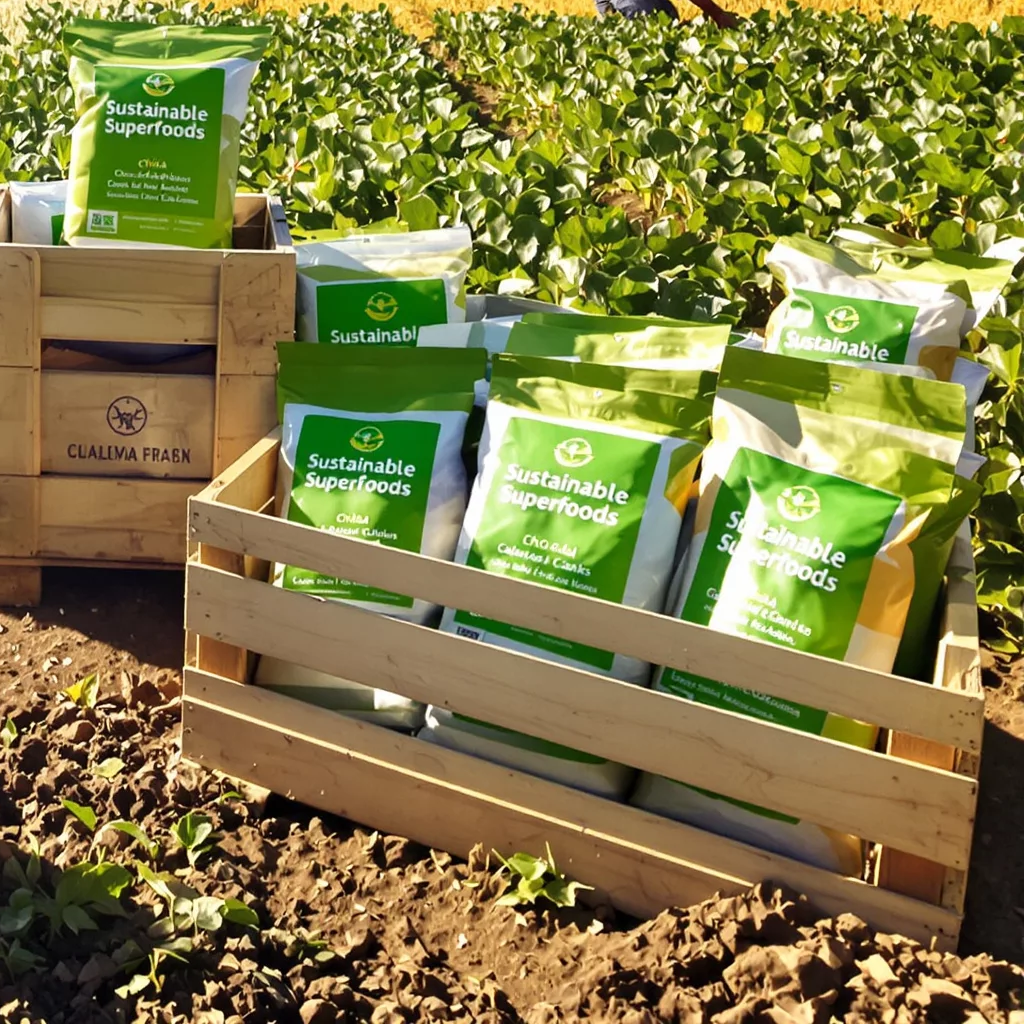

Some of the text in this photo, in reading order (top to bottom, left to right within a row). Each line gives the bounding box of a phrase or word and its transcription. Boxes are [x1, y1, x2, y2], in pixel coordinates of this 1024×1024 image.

[106, 100, 208, 121] Sustainable
[105, 118, 205, 139] Superfoods
[330, 325, 417, 344] Sustainabl
[784, 330, 889, 361] Sustainable
[307, 453, 416, 477] Sustainable
[304, 472, 411, 496] Superfoods
[507, 463, 629, 505] Sustainable
[499, 485, 619, 526] Superfoods
[726, 511, 846, 568] Sutainable
[717, 533, 839, 592] Suerfoods
